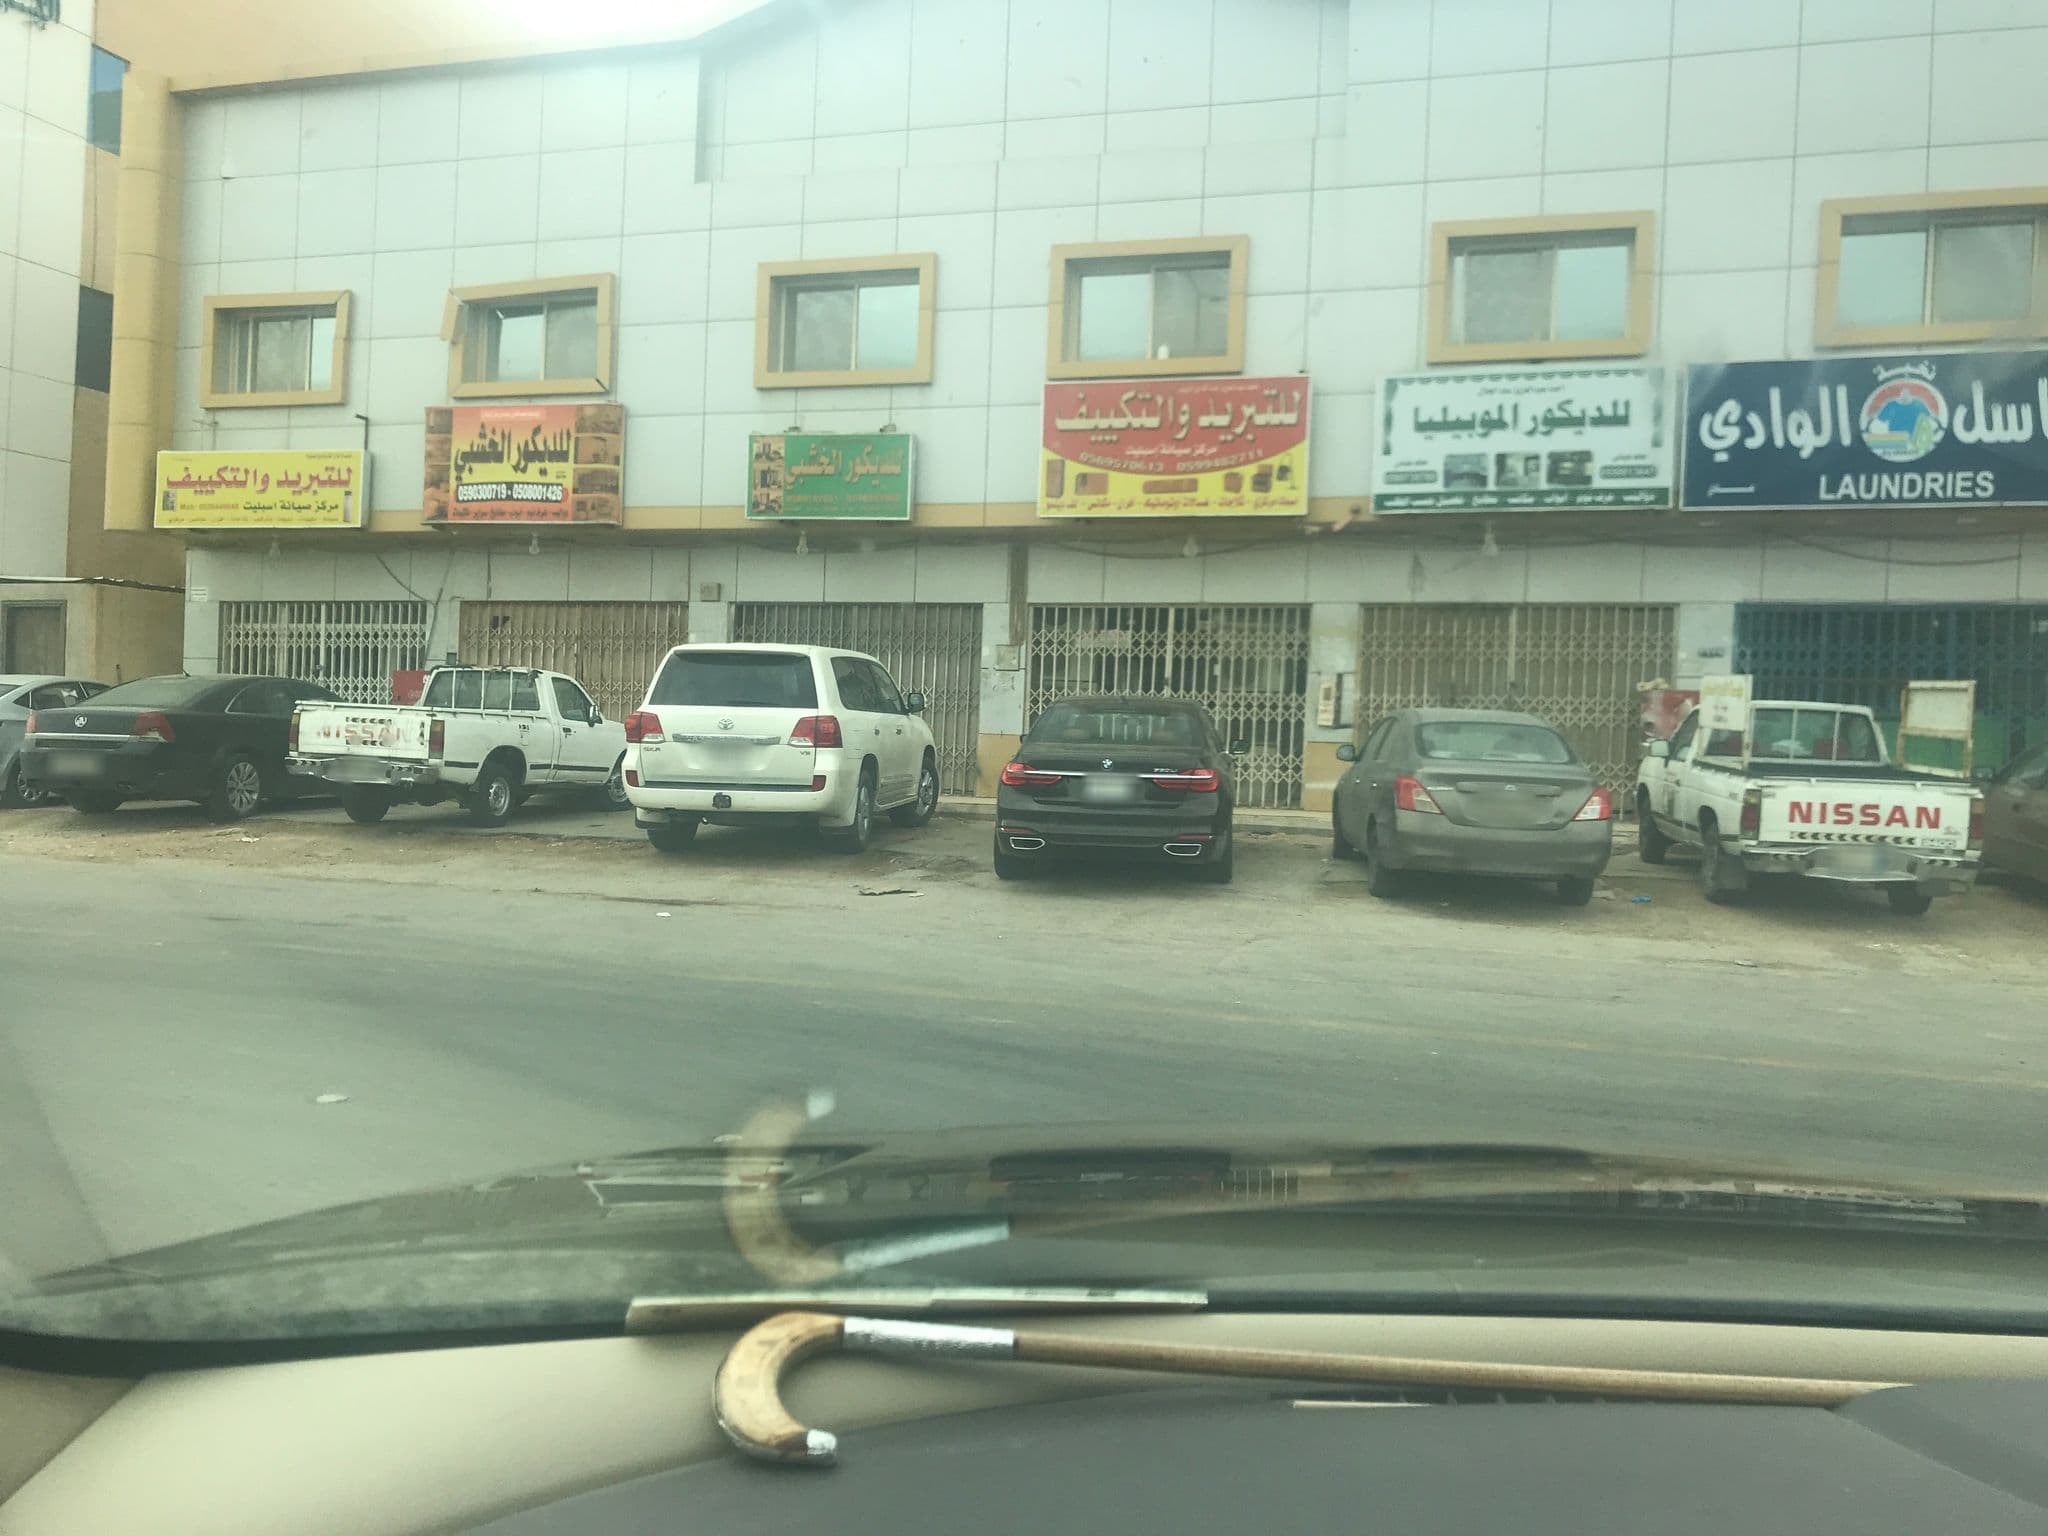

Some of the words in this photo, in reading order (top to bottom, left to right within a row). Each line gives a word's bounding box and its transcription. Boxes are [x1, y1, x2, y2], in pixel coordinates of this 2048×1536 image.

[1055, 389, 1192, 442] والتكييف
[1198, 388, 1302, 442] للتبريد
[1524, 399, 1631, 436] للديكور
[1699, 384, 1851, 463] الوادي
[1952, 375, 2048, 445] اسل
[166, 466, 270, 495] والتكييف
[277, 466, 353, 496] للتبريد
[1818, 470, 1996, 501] LAUNDRIES
[1788, 801, 1940, 830] NISSAN
